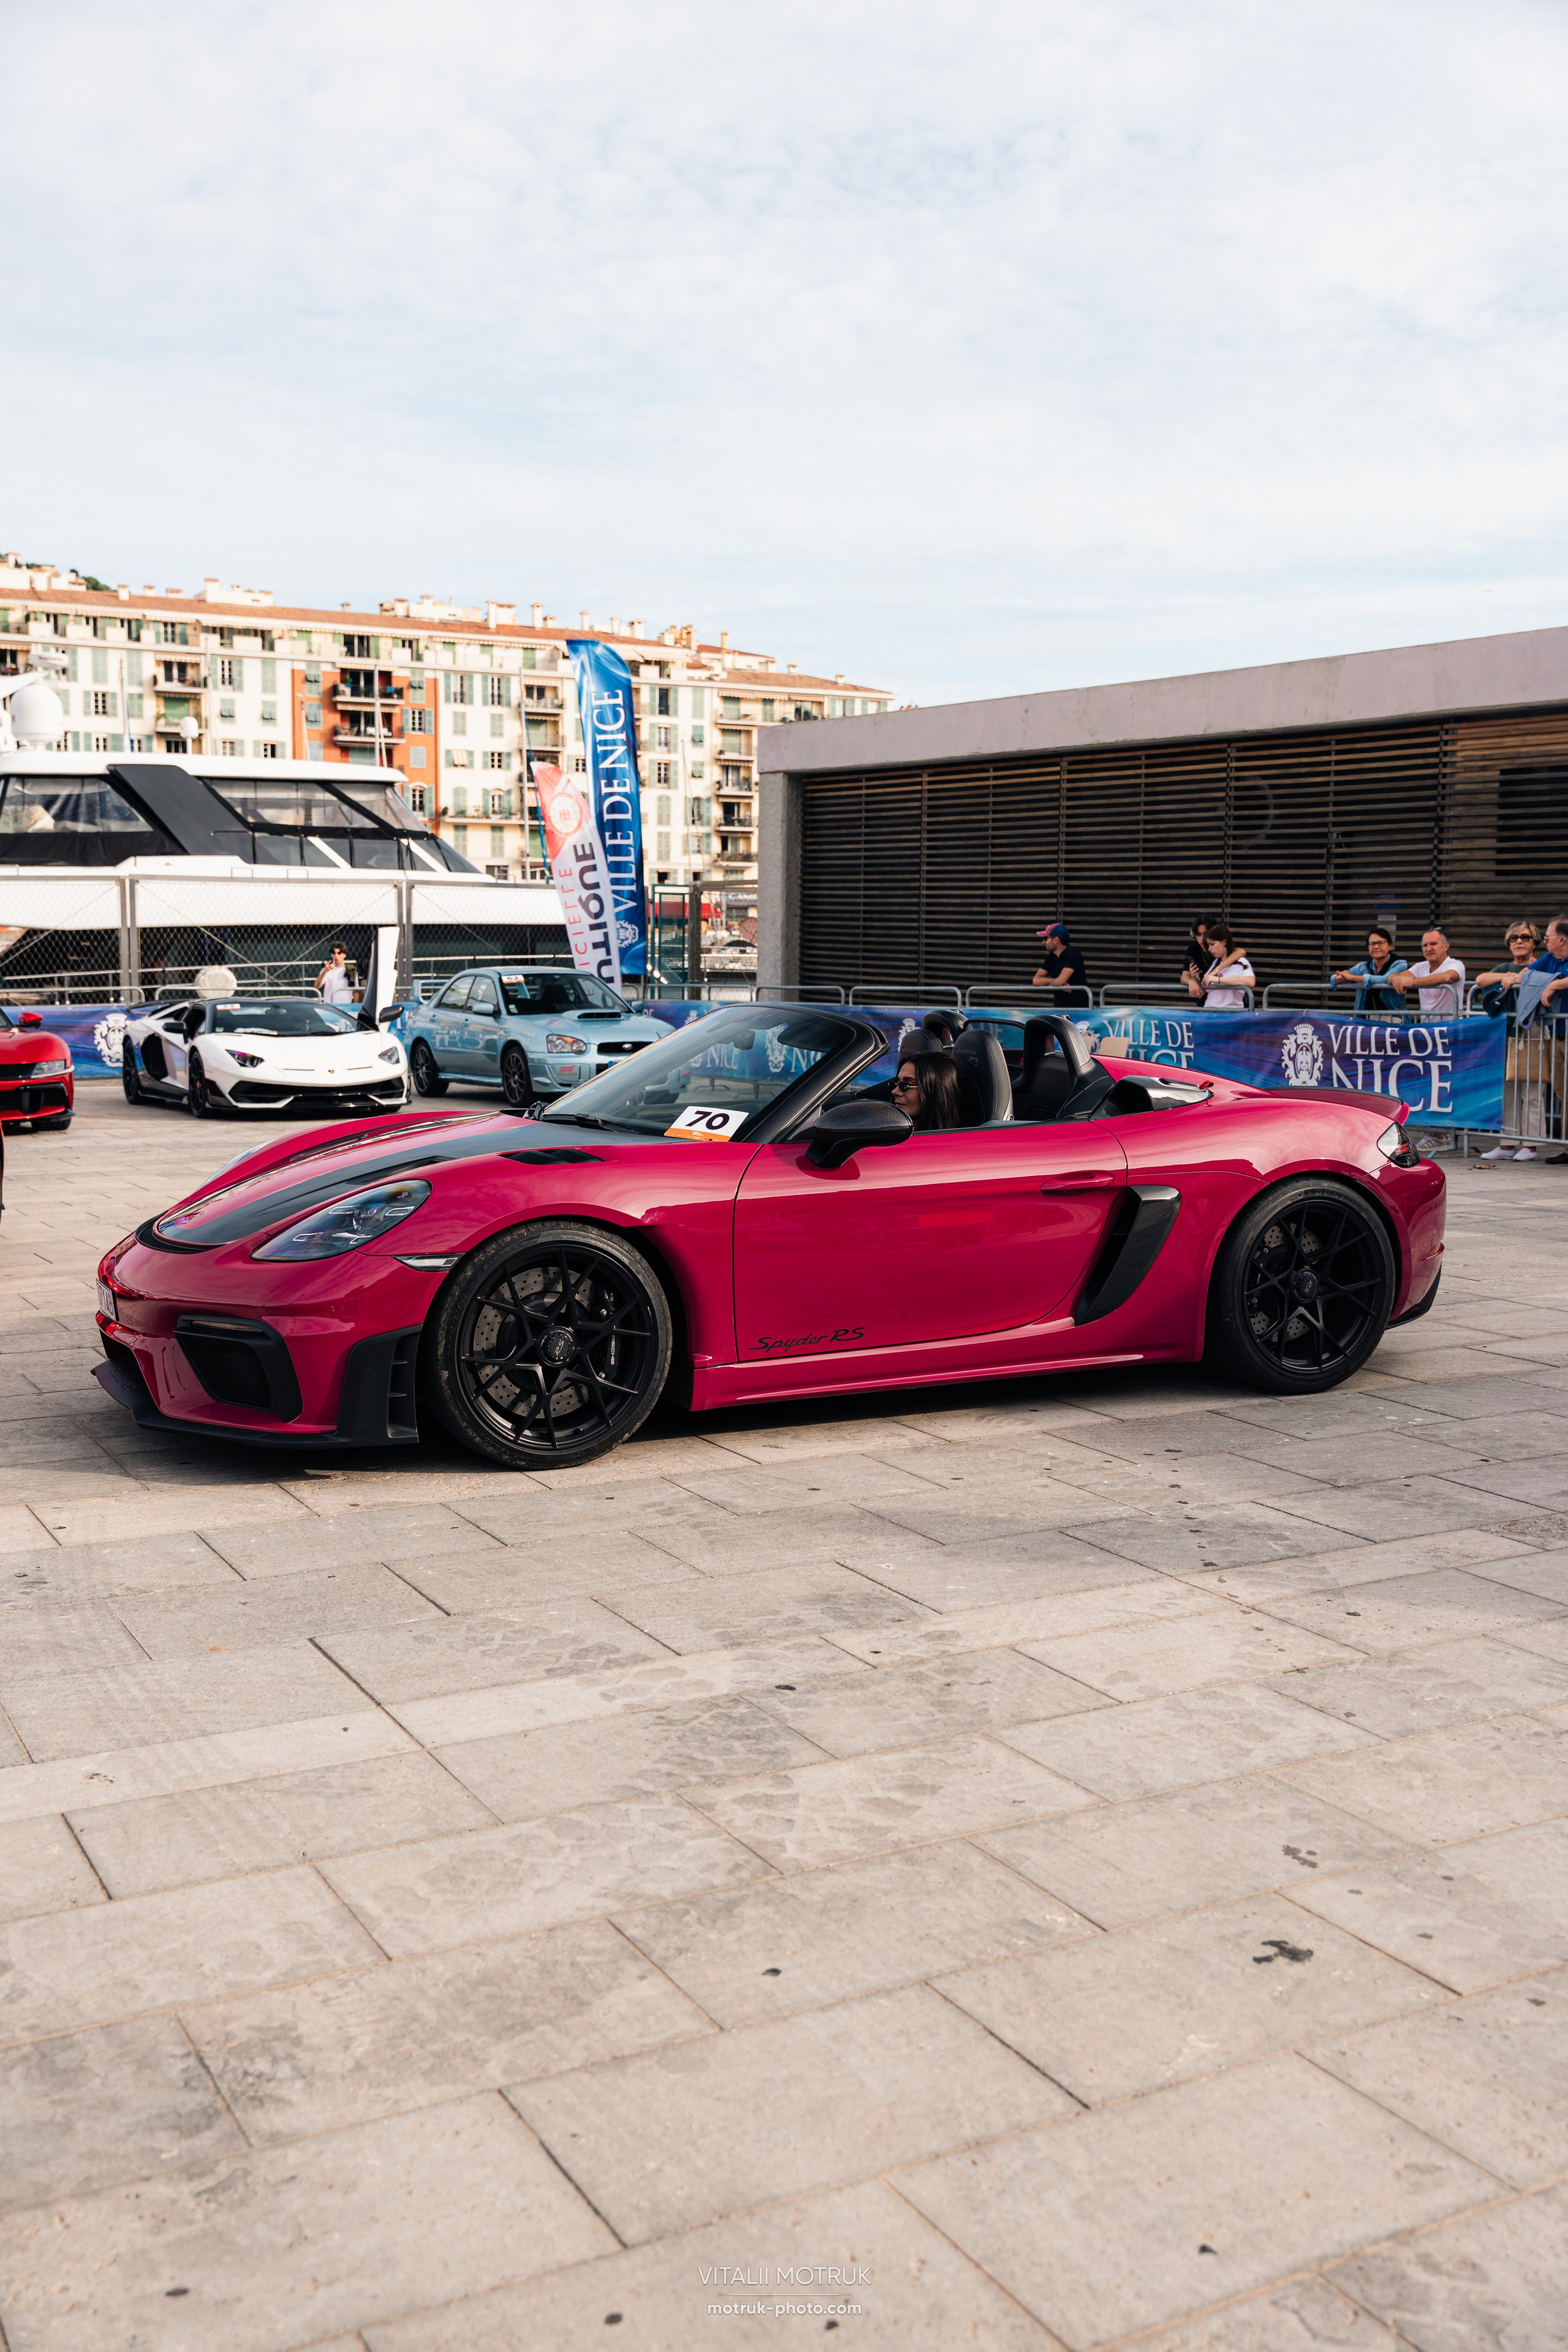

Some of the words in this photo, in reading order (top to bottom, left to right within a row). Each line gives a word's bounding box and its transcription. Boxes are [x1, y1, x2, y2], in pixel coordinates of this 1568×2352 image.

[591, 689, 629, 770] NICE
[600, 778, 633, 822] DE
[605, 831, 638, 913] VILLE
[1102, 1019, 1161, 1046] VILLE
[1164, 1021, 1194, 1049] DE
[1327, 1024, 1400, 1055] VILLE
[1408, 1027, 1452, 1057] DE
[1332, 1057, 1453, 1113] NICE
[685, 1110, 730, 1130] 70
[554, 1338, 564, 1357] RS
[747, 1333, 828, 1353] Spyder
[829, 1327, 865, 1343] RS
